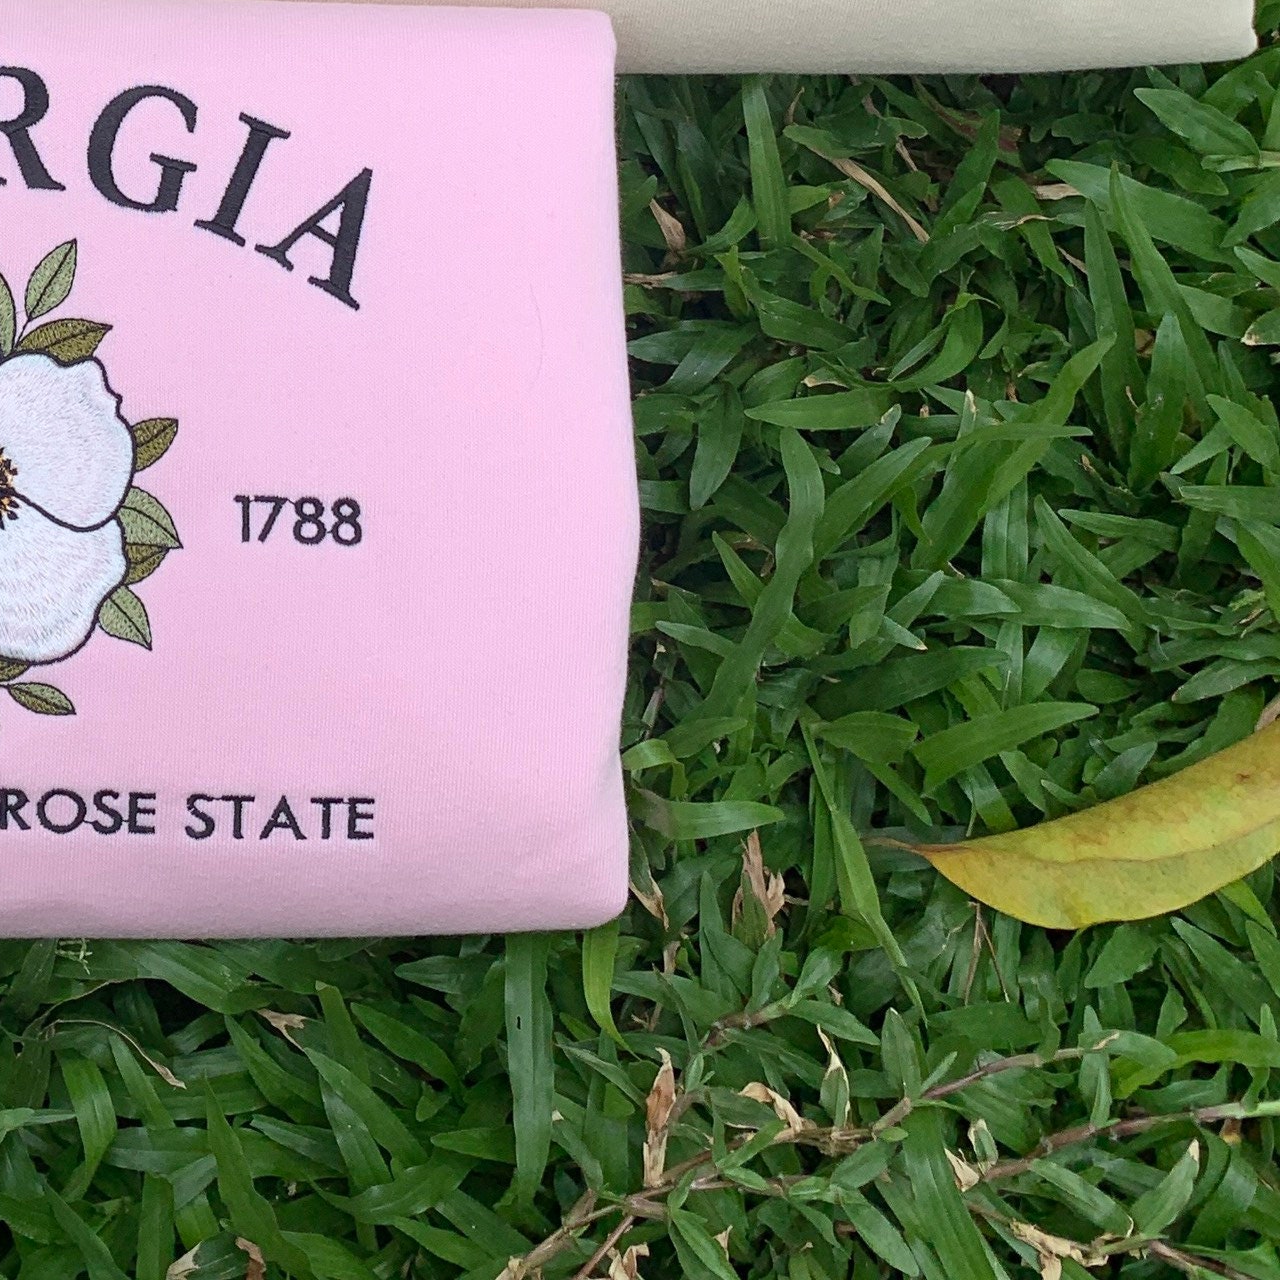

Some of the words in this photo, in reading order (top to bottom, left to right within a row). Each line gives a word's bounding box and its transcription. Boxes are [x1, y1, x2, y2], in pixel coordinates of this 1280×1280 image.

[234, 495, 362, 546] 1788
[0, 788, 156, 835] ROSE
[185, 794, 375, 840] STATE
